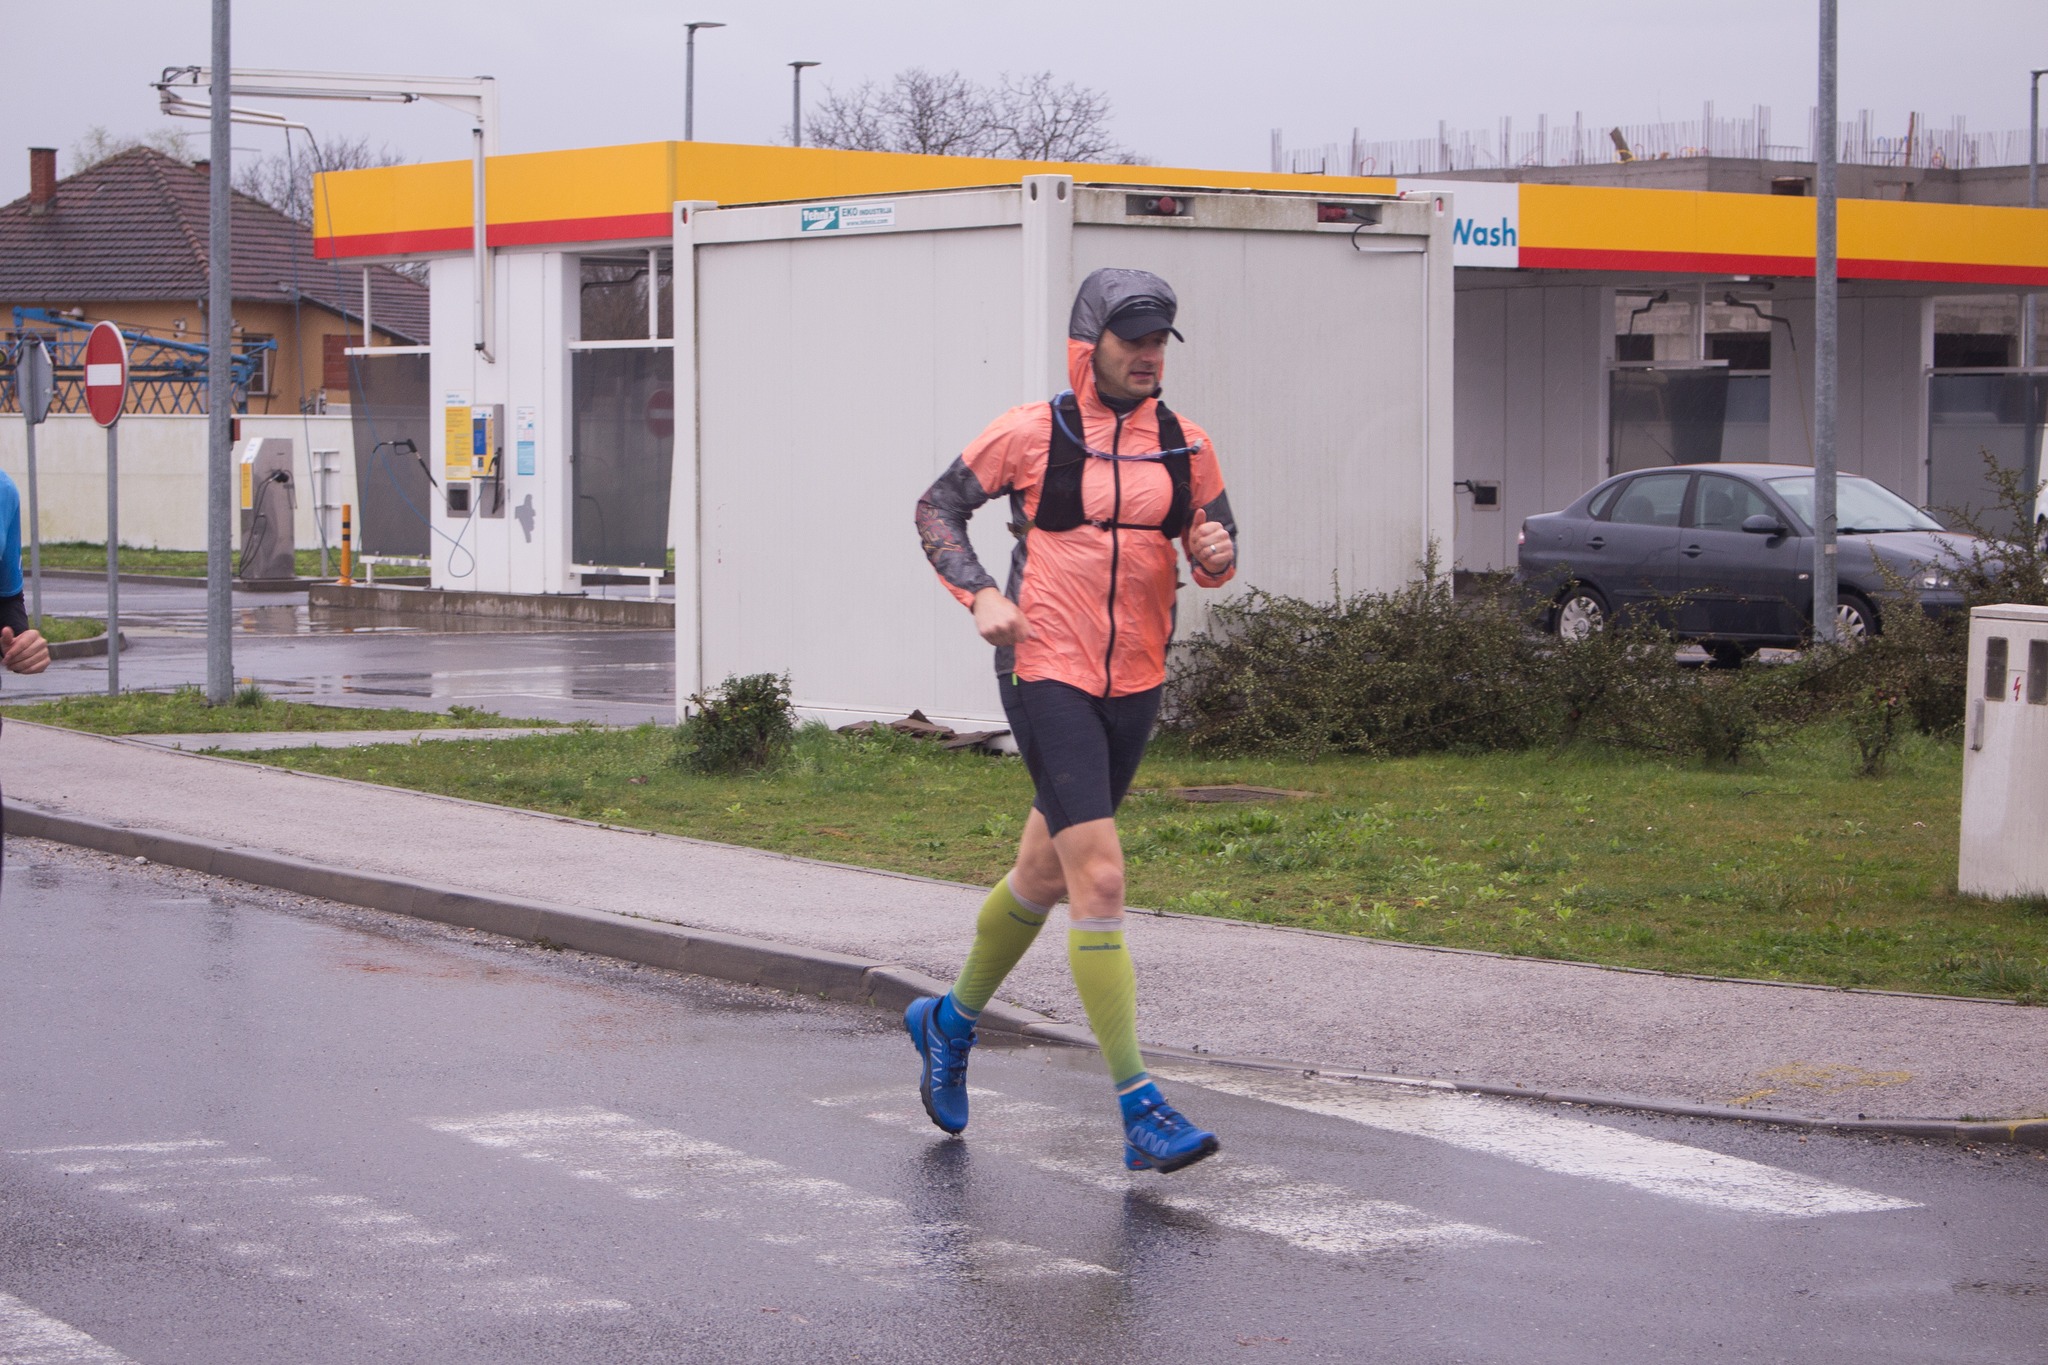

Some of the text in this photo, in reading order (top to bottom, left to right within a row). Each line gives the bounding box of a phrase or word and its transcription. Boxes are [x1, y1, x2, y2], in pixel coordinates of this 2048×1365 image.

[842, 207, 892, 217] EKO INDUSTRIJA
[1453, 217, 1516, 246] Wash
